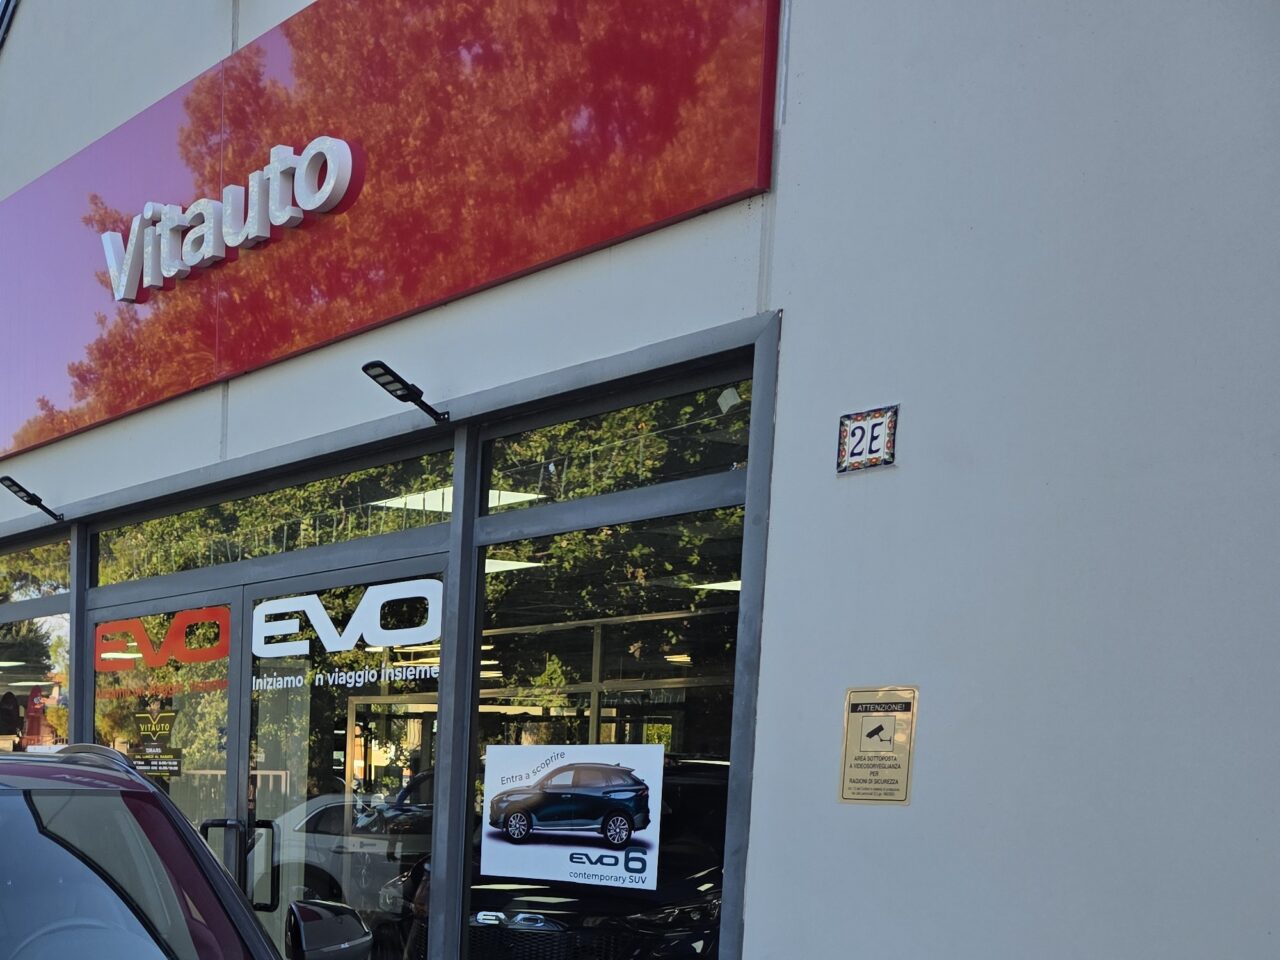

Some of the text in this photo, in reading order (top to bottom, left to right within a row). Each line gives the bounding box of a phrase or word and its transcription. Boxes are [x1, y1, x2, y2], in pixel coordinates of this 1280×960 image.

[101, 136, 353, 303] Vitauto
[850, 421, 884, 458] 2E
[252, 578, 444, 658] EVO
[95, 606, 231, 672] EVO
[252, 672, 304, 691] Iniziamo
[327, 665, 378, 688] viaggio
[381, 662, 440, 684] insieme
[856, 704, 905, 712] ATTENZIONE!
[500, 773, 523, 786] Entra
[531, 750, 566, 776] scoprire
[569, 846, 648, 874] EVO 6
[569, 871, 648, 885] contemporary SUV
